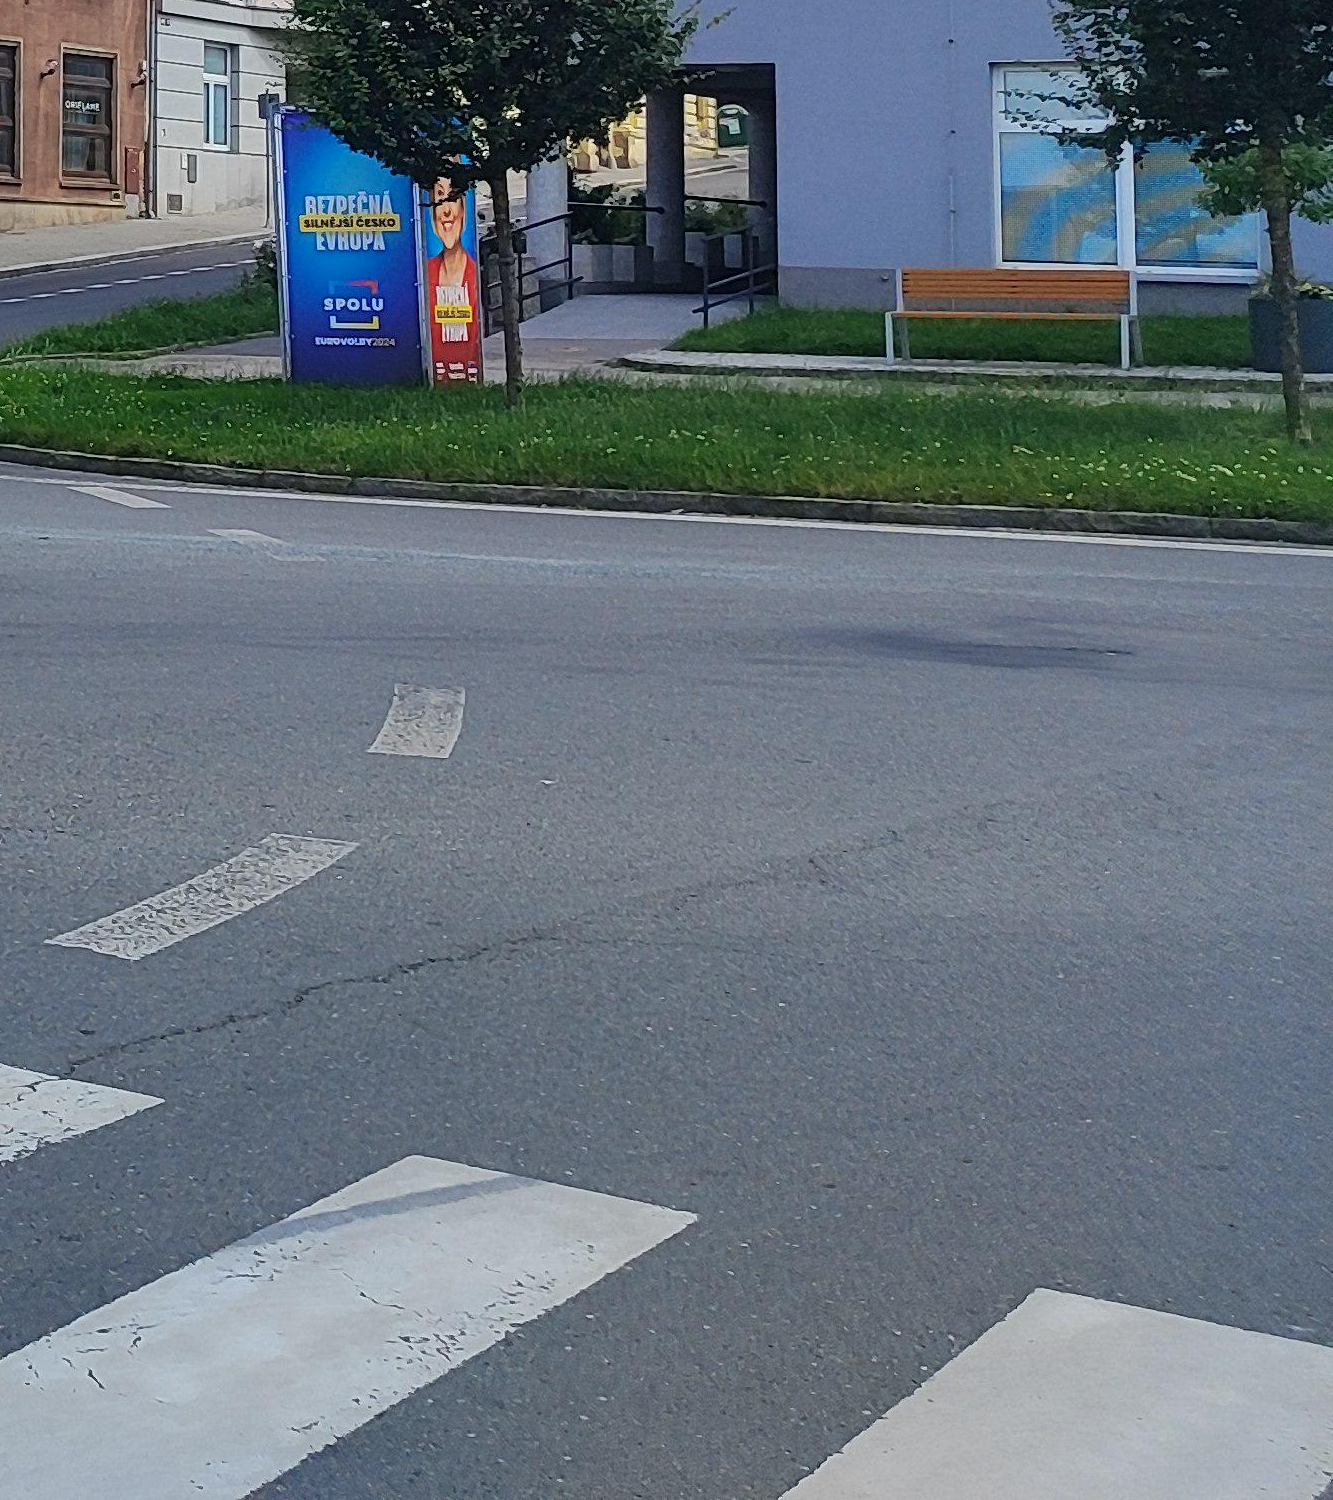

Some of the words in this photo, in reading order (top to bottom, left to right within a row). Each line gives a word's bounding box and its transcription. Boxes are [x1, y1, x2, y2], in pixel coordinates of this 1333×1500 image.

[303, 216, 354, 229] SILNĚJŠÍ
[355, 216, 396, 228] ČESKO
[323, 297, 384, 311] SPOLU
